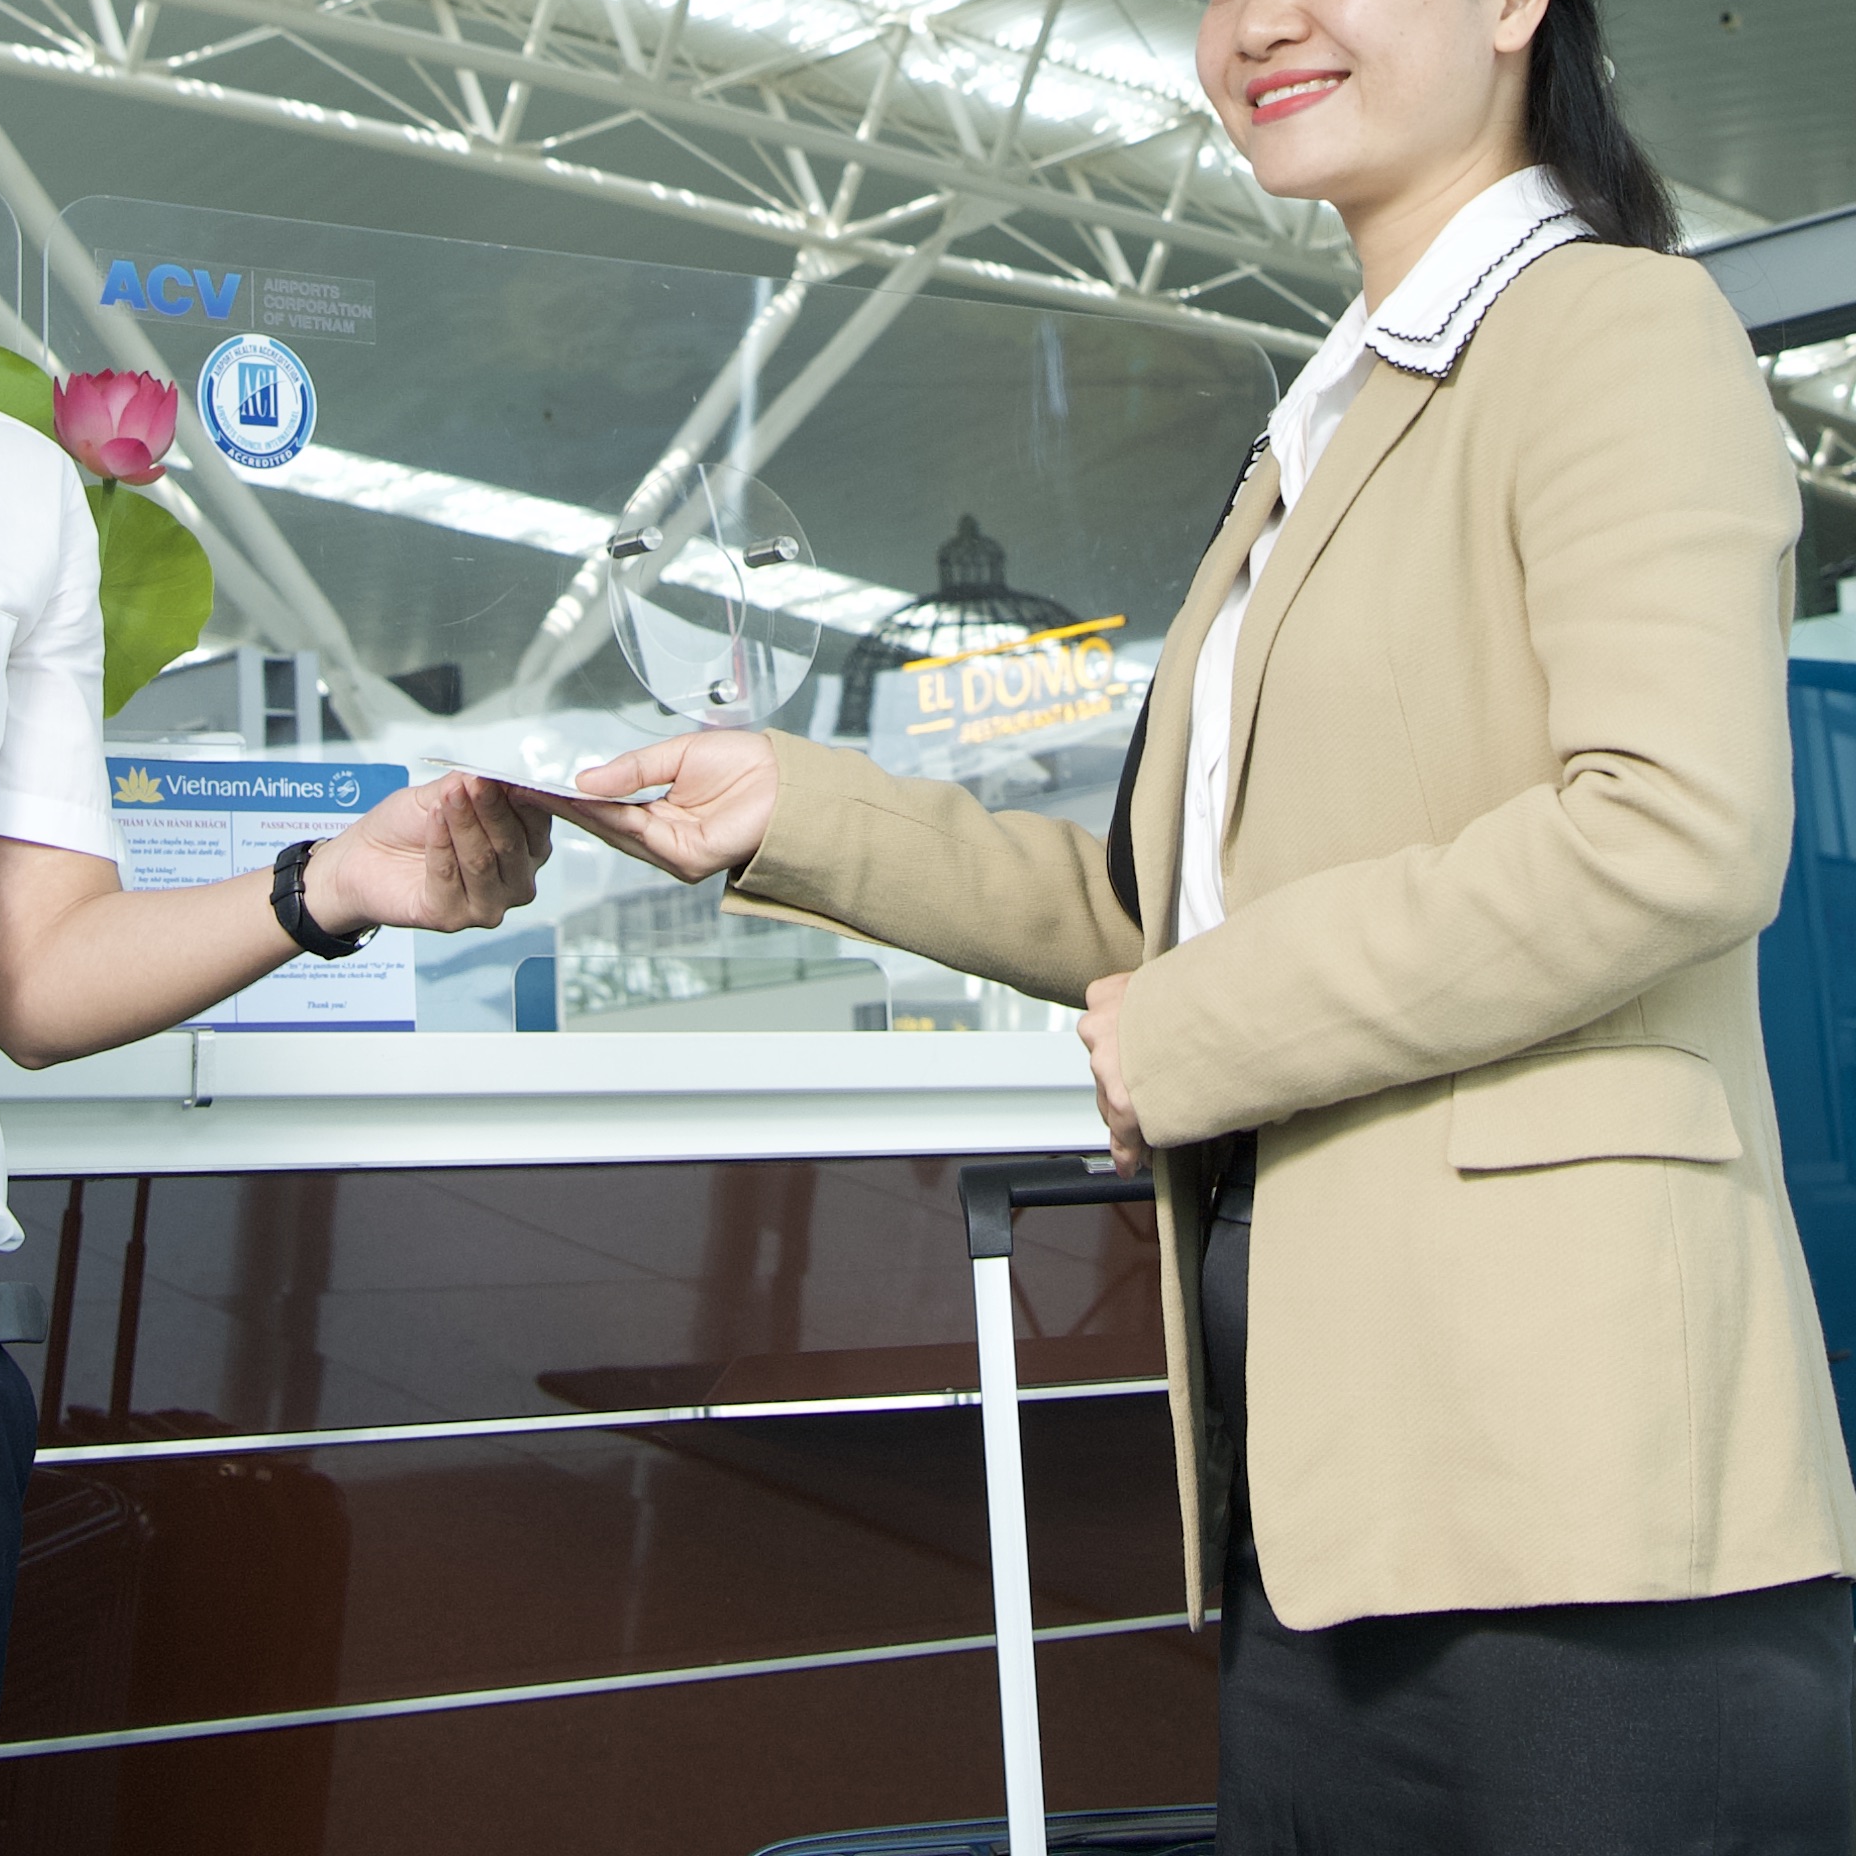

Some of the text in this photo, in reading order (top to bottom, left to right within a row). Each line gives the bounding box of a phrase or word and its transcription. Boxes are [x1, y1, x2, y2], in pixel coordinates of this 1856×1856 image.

[100, 259, 242, 320] ACV
[263, 278, 340, 299] AIRPORTS
[263, 296, 373, 319] CORPORATION
[263, 312, 356, 334] OF VIETNAM
[213, 344, 301, 383] AIRPORT HEALTH ACCREDITATION
[241, 367, 276, 418] ACI
[227, 448, 293, 467] ACCREDITED
[918, 636, 1114, 715] EL DOMO
[260, 820, 310, 830] PASSENGER
[307, 1001, 347, 1010] Thank you!
